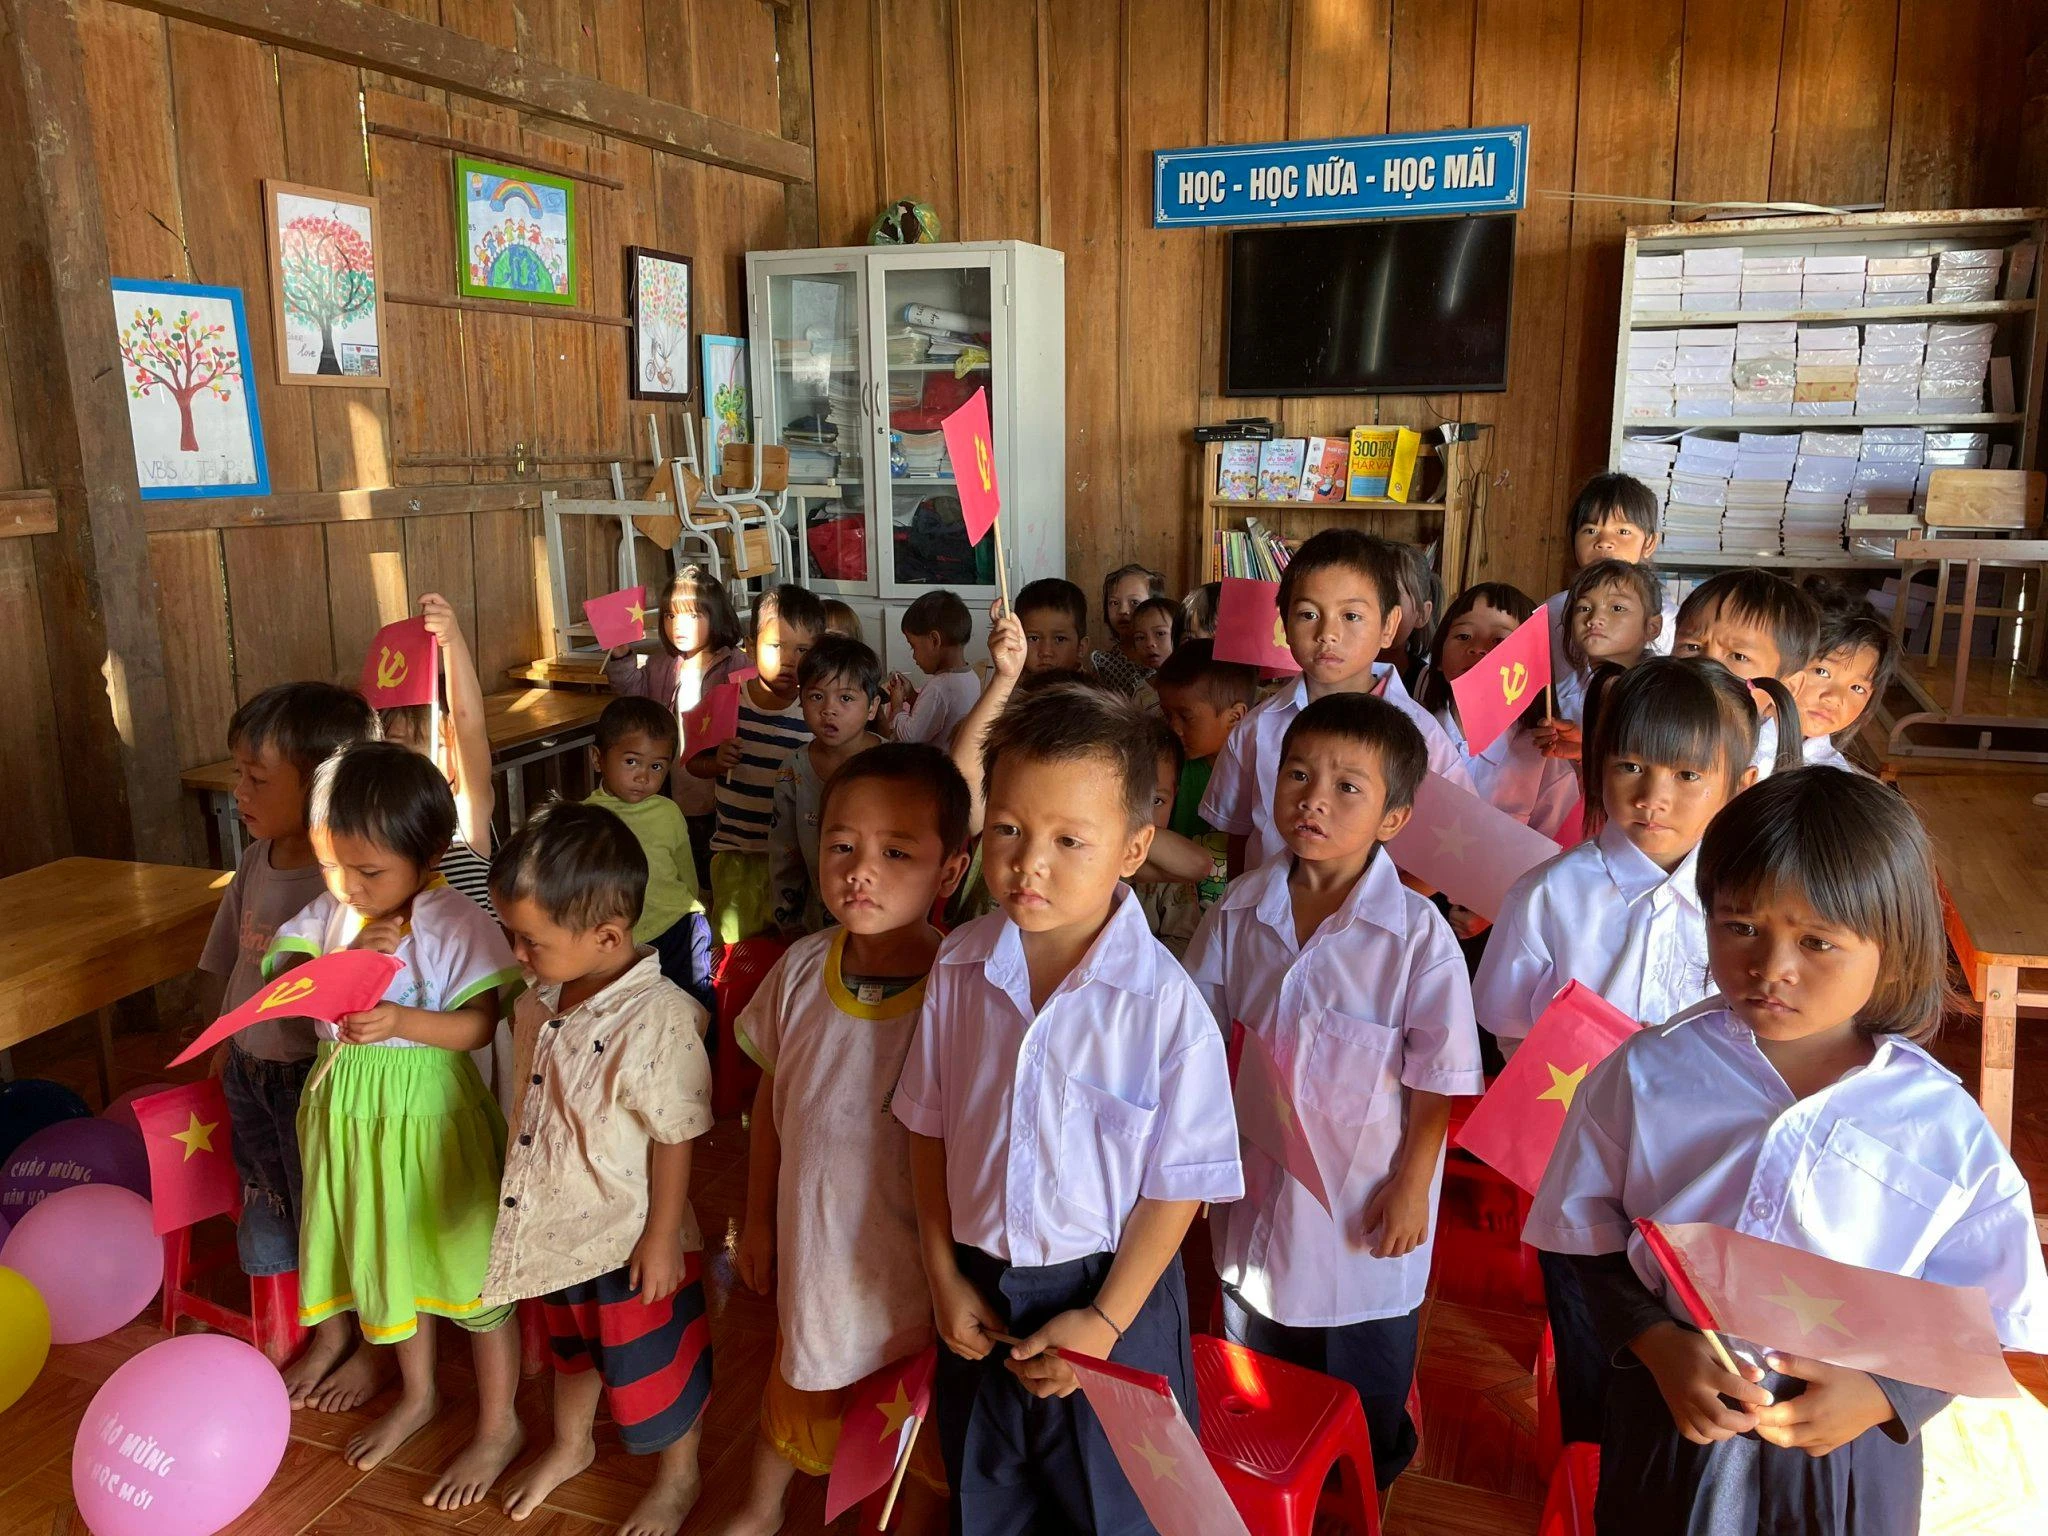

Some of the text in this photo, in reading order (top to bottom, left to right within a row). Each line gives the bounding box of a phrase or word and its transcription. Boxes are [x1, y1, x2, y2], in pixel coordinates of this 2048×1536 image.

[1178, 170, 1226, 211] HỌC
[1250, 165, 1298, 207] HỌC
[1306, 156, 1358, 198] NỮA
[1383, 156, 1436, 199] HỌC
[1443, 146, 1496, 189] MÃI
[1351, 459, 1392, 470] HARVA
[1353, 440, 1378, 458] 300
[118, 1432, 175, 1478] MỪNG
